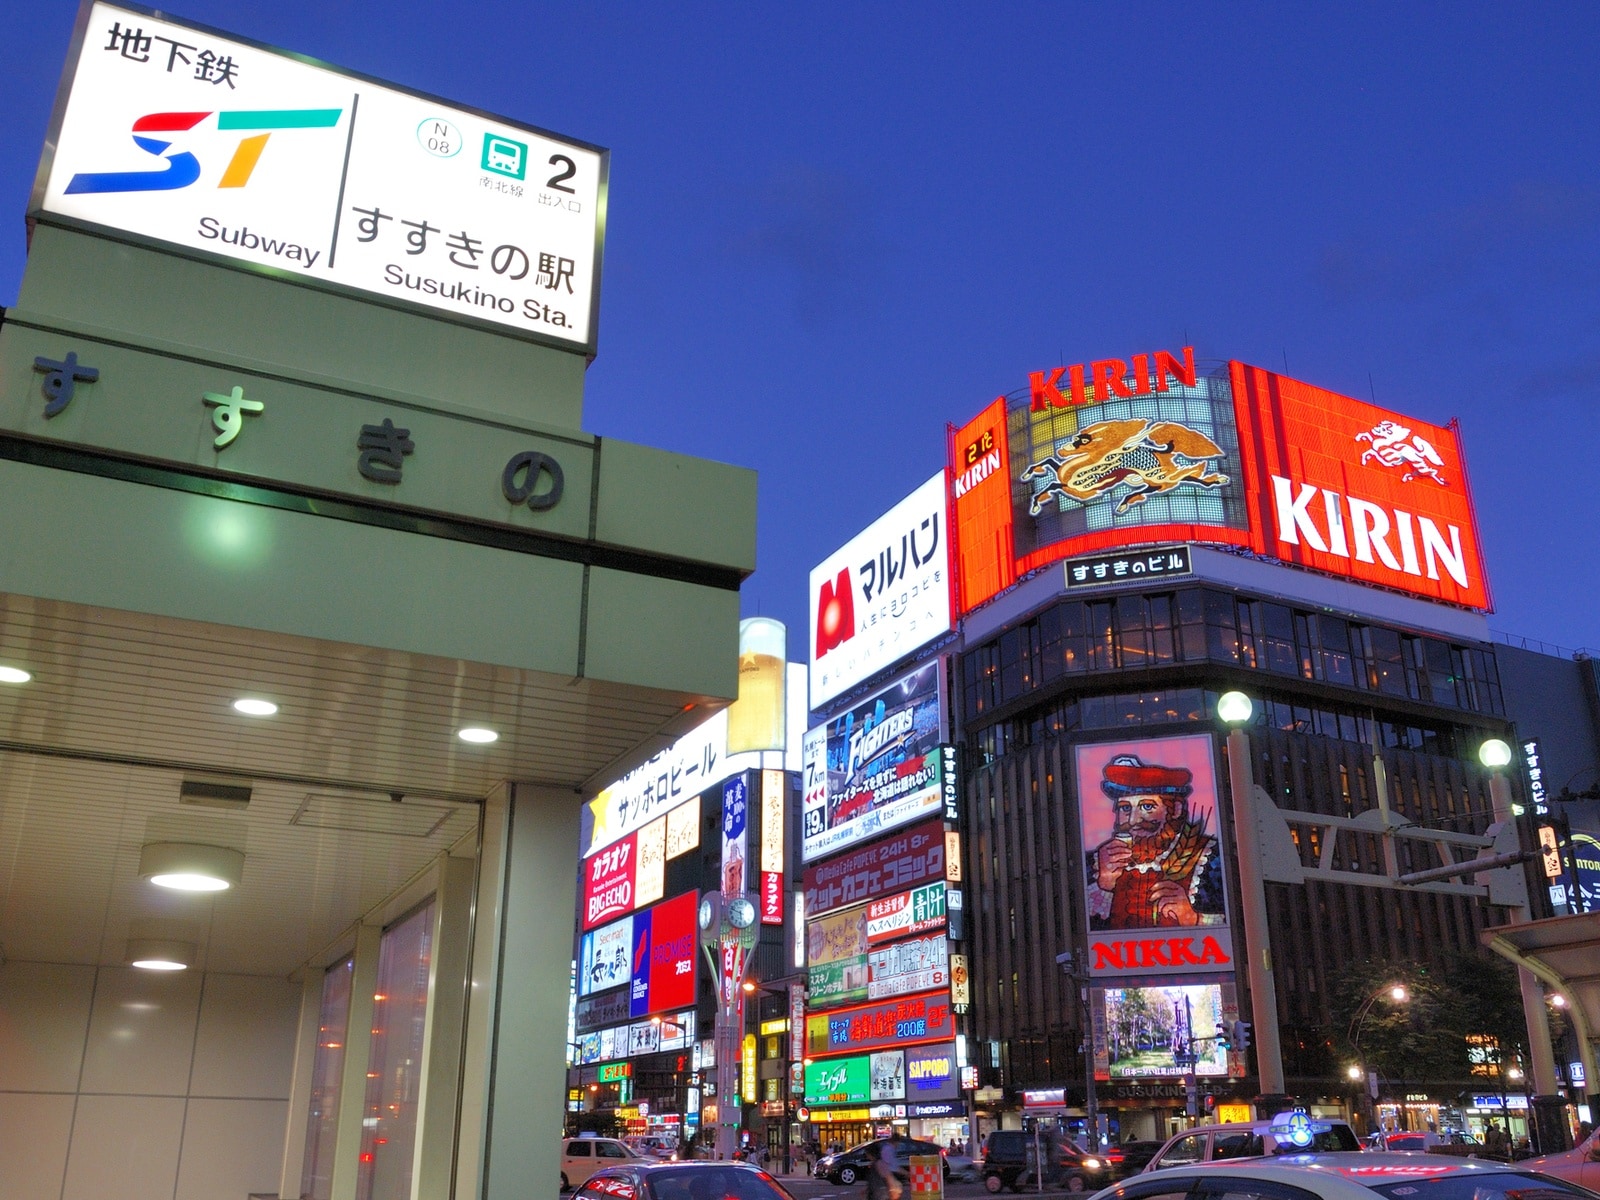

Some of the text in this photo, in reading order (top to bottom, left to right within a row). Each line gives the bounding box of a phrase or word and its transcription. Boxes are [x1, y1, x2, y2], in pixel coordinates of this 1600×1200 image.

[104, 21, 240, 91] 地下鉄
[427, 137, 450, 155] 08
[434, 122, 448, 137] N
[478, 175, 524, 199] 南北線
[546, 153, 578, 195] 2
[537, 192, 582, 214] 出入口
[197, 215, 321, 269] Subway
[352, 206, 576, 296] すすきの駅
[384, 264, 574, 329] Susukino Sta.
[1028, 346, 1197, 412] KIRIN
[955, 448, 1001, 499] KIRIN
[1271, 474, 1470, 589] KIRIN
[860, 511, 939, 604] マルハン
[1072, 552, 1184, 581] すすきのビル
[860, 569, 942, 633] 人生にヨロコビを
[844, 705, 915, 787] FIGHTERS
[618, 741, 718, 829] サッポロビール
[806, 761, 816, 788] 7
[943, 746, 958, 819] すすきのビル
[1524, 741, 1548, 815] すすきのビル
[592, 842, 631, 882] カラオケ
[879, 838, 908, 860] 24H
[910, 834, 930, 849] 8F
[1563, 857, 1600, 871] SNTOR
[605, 880, 631, 908] ECHO
[766, 872, 780, 916] カラオケ
[914, 887, 944, 921] 青汁
[653, 933, 693, 964] PROMISE
[1090, 935, 1230, 970] NIKKA
[927, 1004, 949, 1028] 2F
[953, 1003, 969, 1014] 4F
[909, 1057, 949, 1079] SAPPORO
